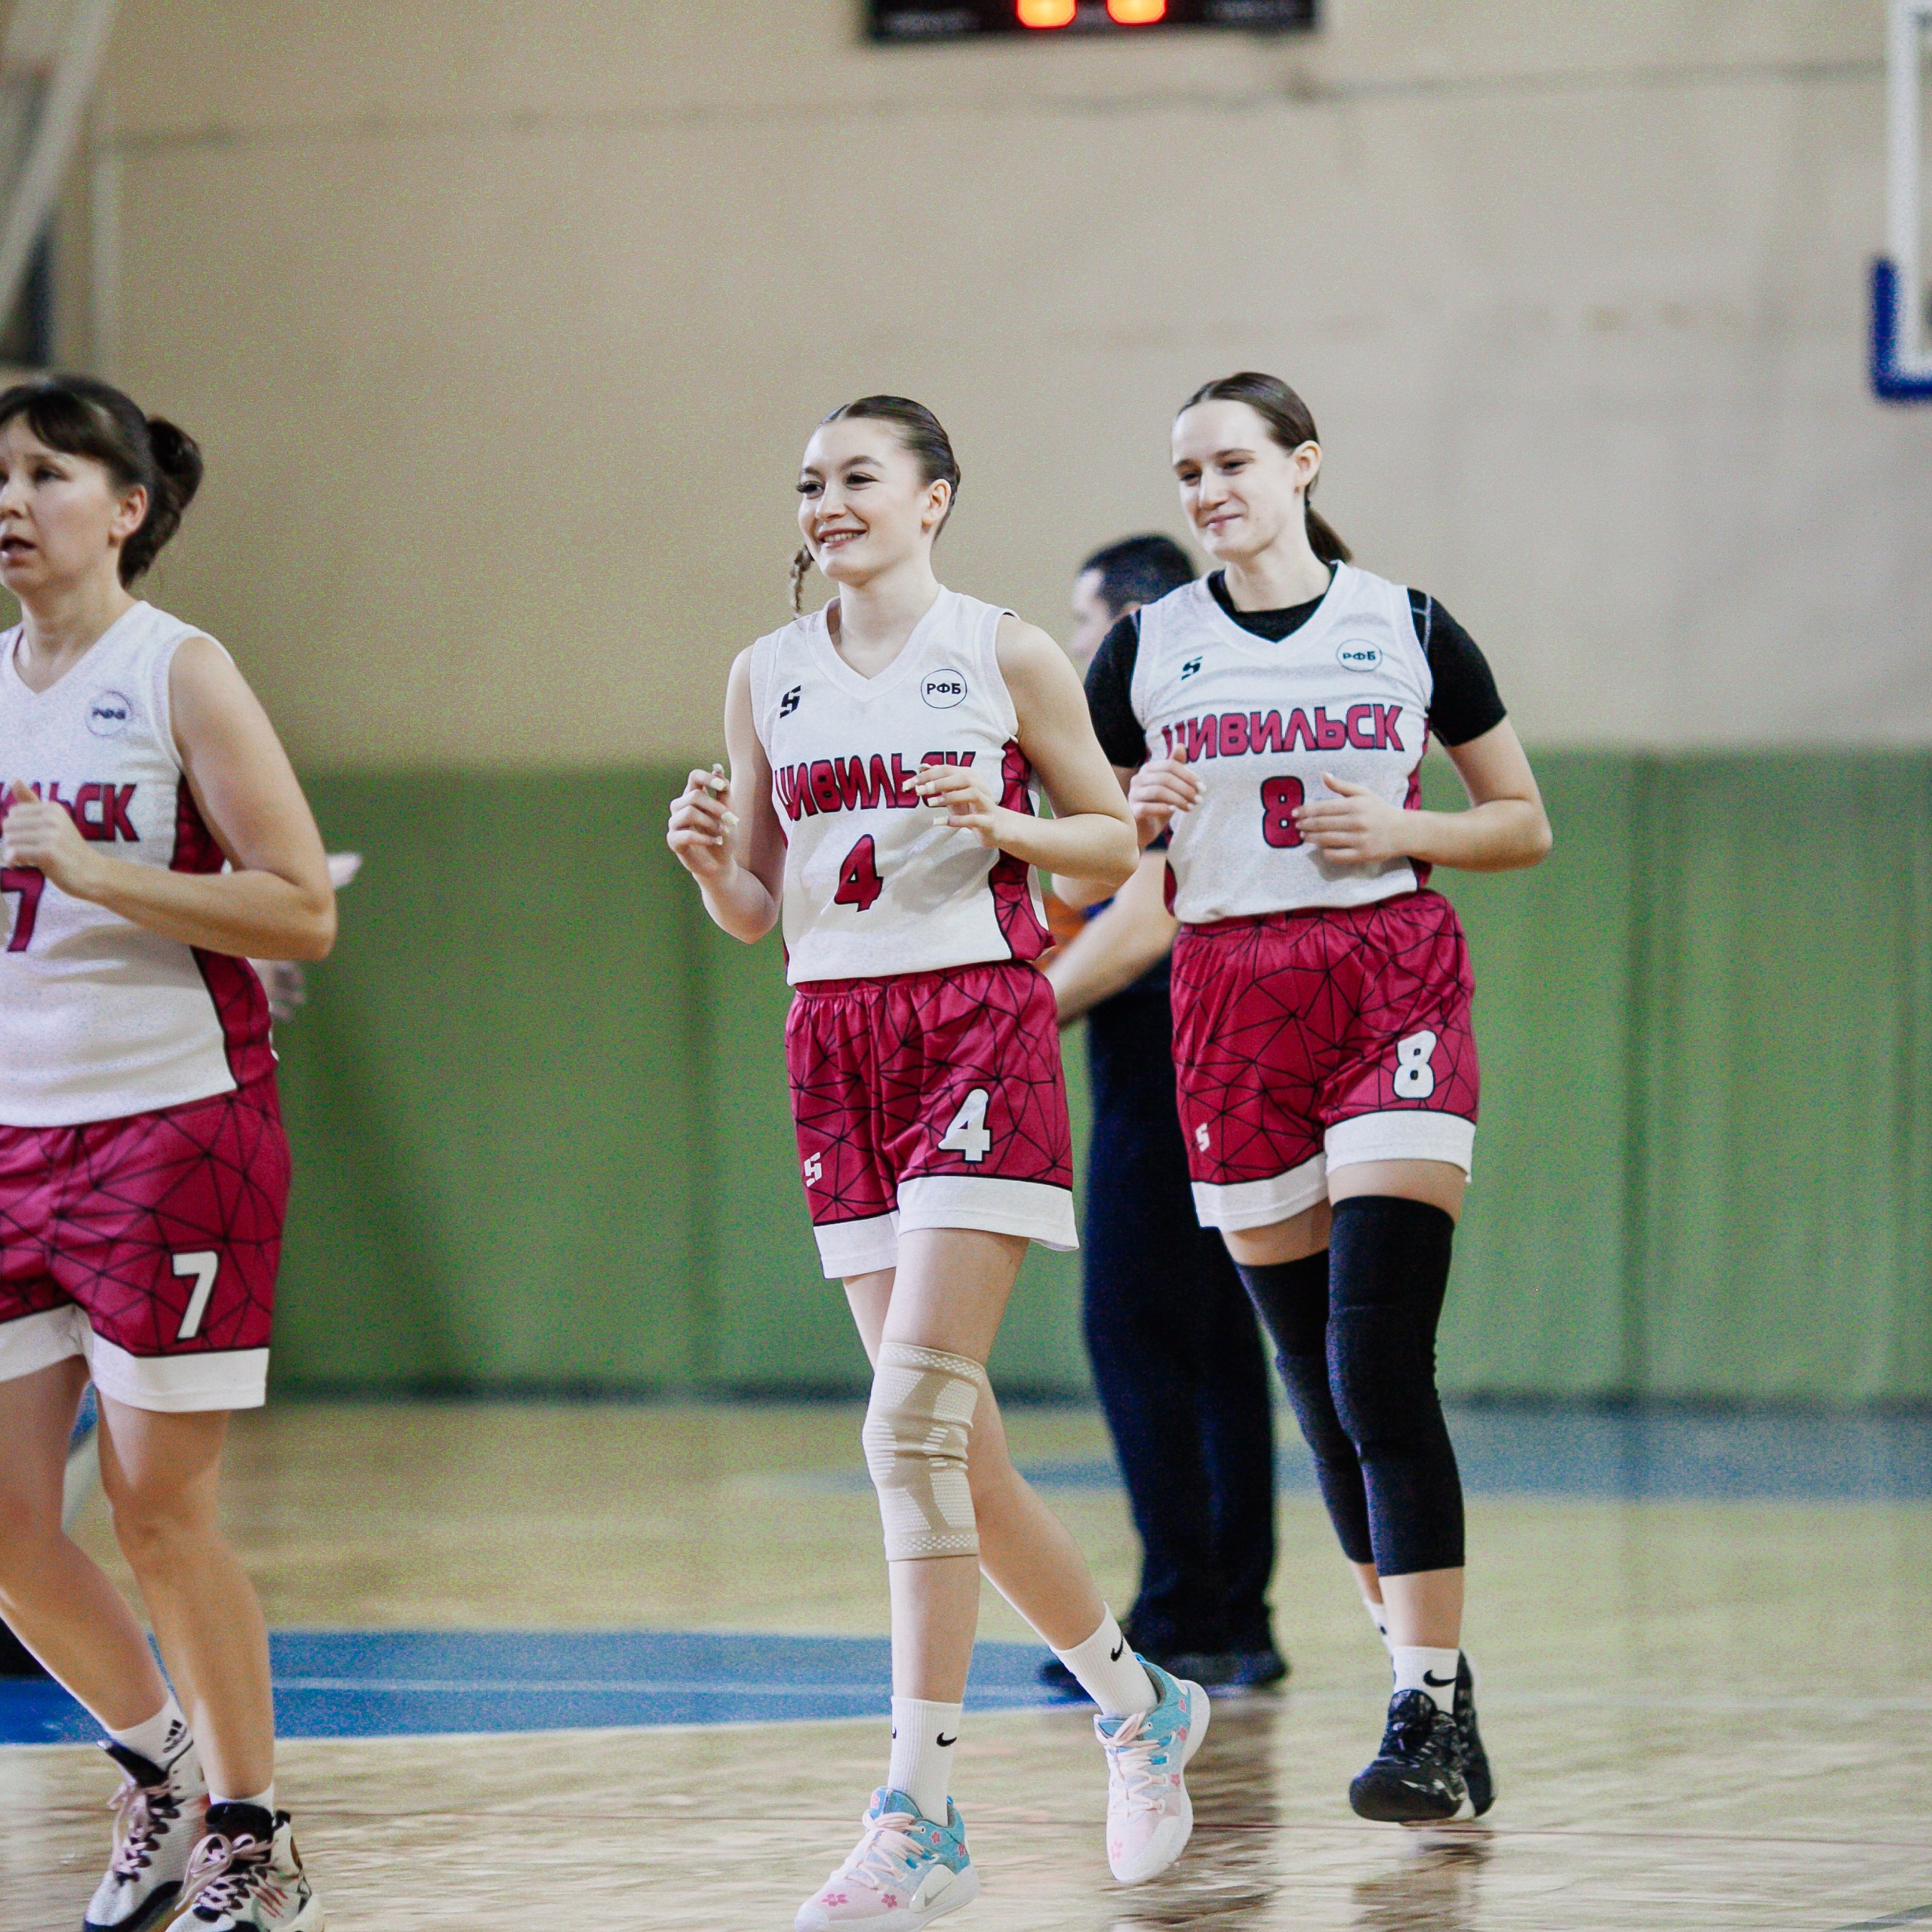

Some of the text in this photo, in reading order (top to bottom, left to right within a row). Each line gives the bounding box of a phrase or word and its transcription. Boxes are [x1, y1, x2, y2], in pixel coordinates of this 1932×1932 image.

[926, 682, 961, 695] РФБ
[1343, 651, 1376, 661] РФБ
[1260, 775, 1305, 849] 8
[0, 864, 45, 952] 7
[833, 833, 884, 912] 4
[1392, 1029, 1438, 1100] 8
[937, 1087, 991, 1163] 4
[171, 1249, 220, 1342] 7
